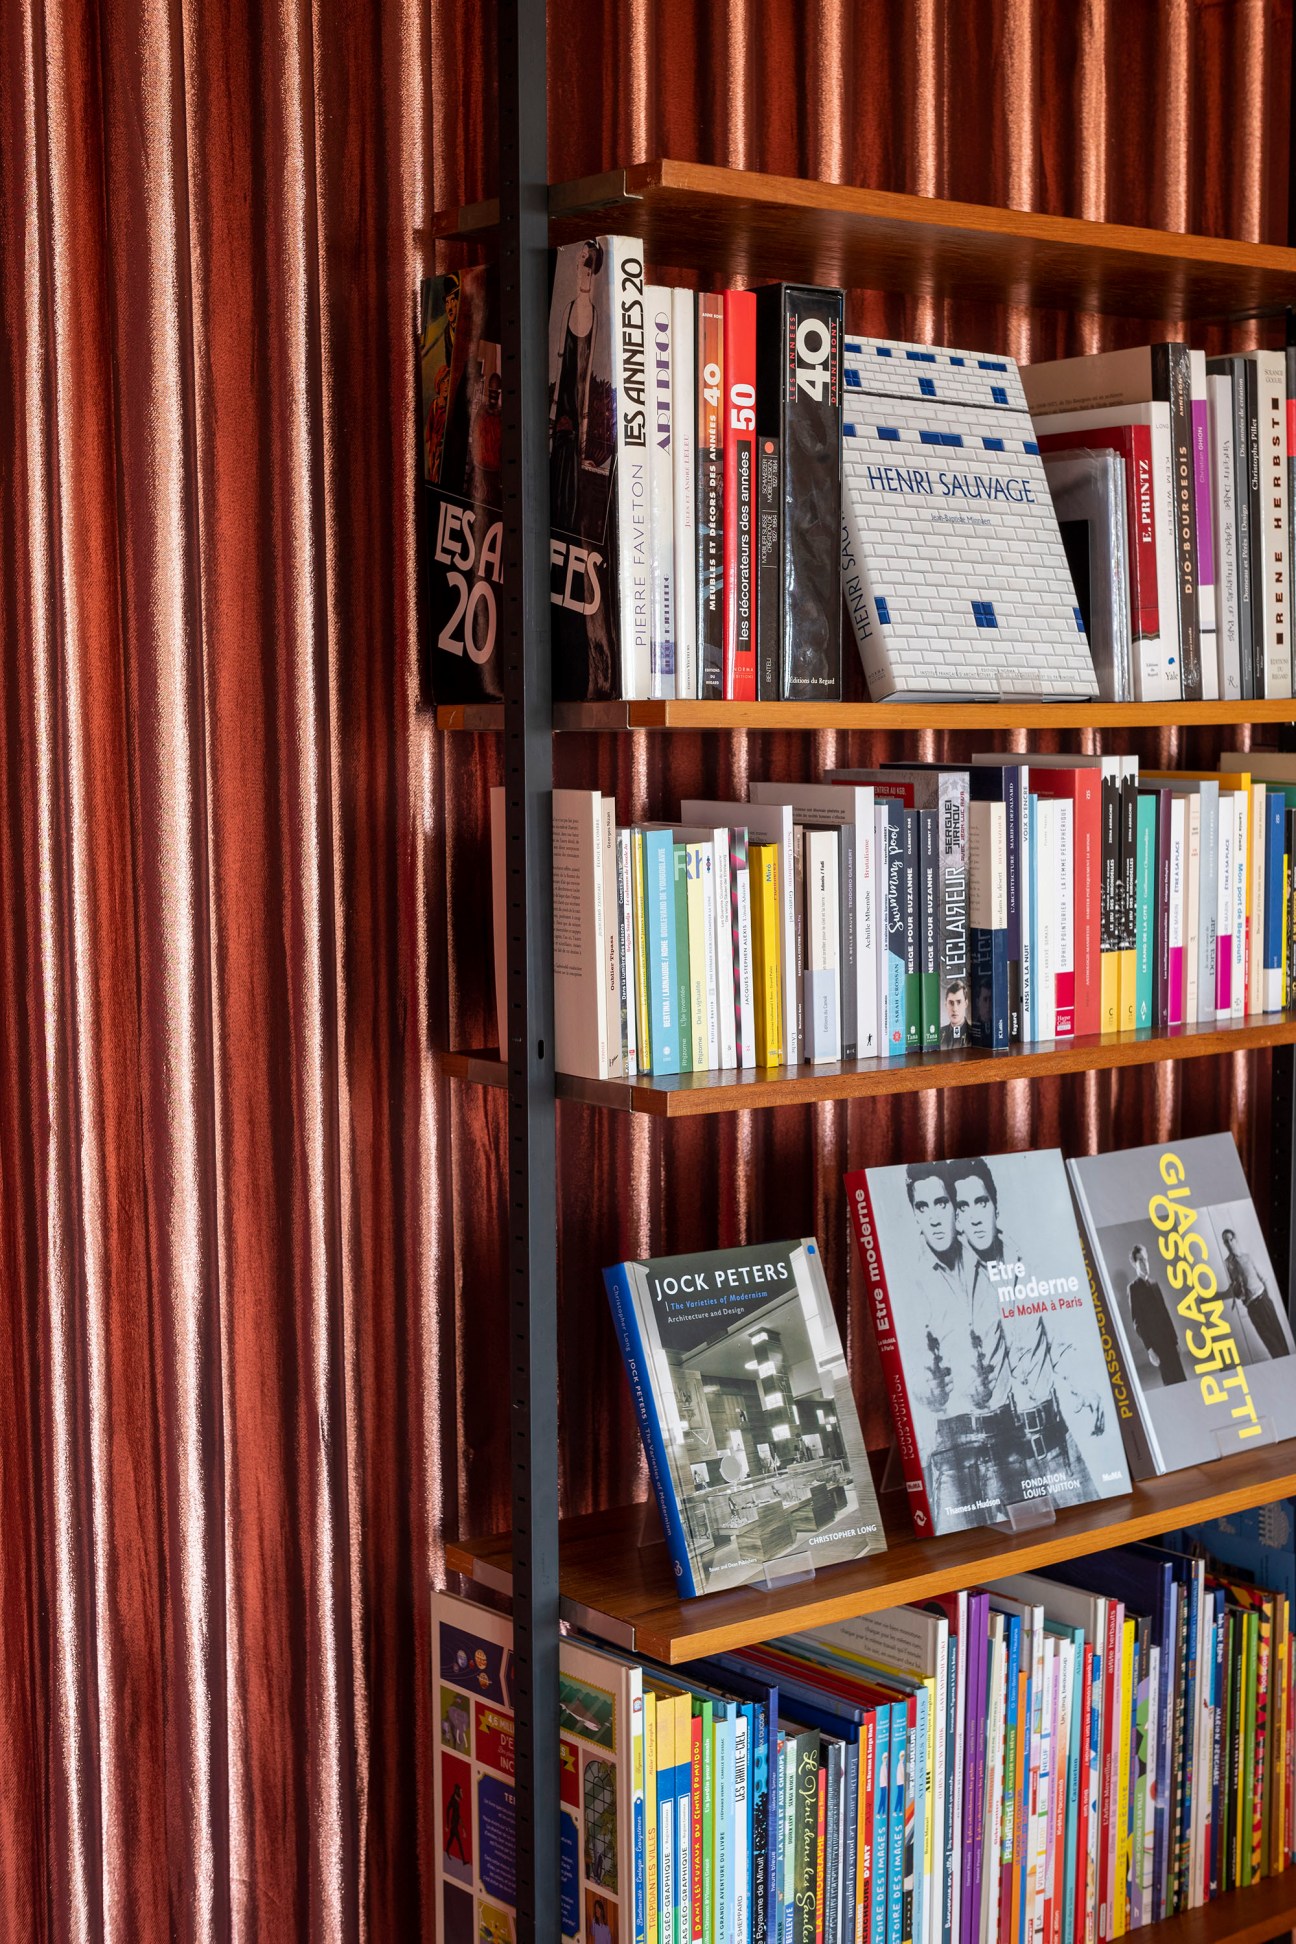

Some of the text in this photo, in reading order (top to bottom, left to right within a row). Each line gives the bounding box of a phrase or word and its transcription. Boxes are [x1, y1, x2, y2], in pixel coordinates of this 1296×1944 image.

[620, 258, 646, 447] LES ANNEES 20
[796, 318, 831, 403] 40
[830, 322, 838, 353] BONY
[654, 311, 671, 456] ART DECO
[703, 363, 721, 407] 40
[707, 414, 717, 462] ANNÉES
[708, 464, 716, 488] DES
[866, 466, 1035, 502] HENRI SAUVAGE
[1251, 442, 1259, 490] Christophe
[707, 490, 717, 537] DÉCORS
[730, 383, 756, 641] les décorateurs des années 50
[1139, 459, 1152, 548] E. PRINTZ
[1179, 446, 1192, 594] DJO-BOURGEOIS
[1271, 417, 1283, 623] RENE HERBST
[434, 500, 476, 571] LES
[631, 464, 648, 646] PIERRE FAVETON
[709, 541, 716, 555] ET
[437, 571, 497, 664] 20
[848, 575, 873, 641] HENRI
[951, 804, 960, 849] JIRNOV
[1059, 808, 1067, 856] PÉRIPHÉRIQUE
[887, 824, 904, 933] Swimming pool
[906, 867, 914, 914] SUZANNE
[926, 867, 934, 914] SUZANNE
[1060, 882, 1066, 890] LA
[1235, 886, 1243, 906] port
[657, 848, 671, 1028] BERTINA LARNAUDIE BOULEVARD DE YOUGOSLAVIE
[926, 917, 934, 943] POUR
[1235, 922, 1244, 964] Beyrouth
[654, 1261, 788, 1301] JOCK PETERS
[854, 1188, 890, 1331] Etre moderne
[986, 1260, 1026, 1282] Etre
[670, 1289, 768, 1310] The Varieties of Modernism
[997, 1274, 1079, 1302] moderne
[1002, 1296, 1083, 1319] Le MoMA à Paris
[1148, 1194, 1230, 1406] PICASSO
[1159, 1152, 1262, 1440] GIACOMETTI
[668, 1305, 746, 1324] Architecture and Design
[628, 1358, 648, 1420] JOCK PETERS
[1021, 1472, 1066, 1489] FONDATION
[1023, 1479, 1080, 1500] LOUIS VUITTON
[808, 1523, 877, 1546] CHRISTOPHER LONG
[693, 1741, 701, 1788] POMPIDOU
[734, 1732, 746, 1784] GRATTE-CIEL
[693, 1791, 701, 1819] CENTRE
[778, 1807, 784, 1818] ET
[693, 1824, 701, 1838] DU
[777, 1844, 784, 1853] LA
[795, 1749, 818, 1943] Le Vent dans les Saules
[647, 1827, 656, 1930] TRÉPIDANTES VILLES
[847, 1838, 856, 1917] poids papillon
[876, 1826, 886, 1900] DES IMAGES
[892, 1824, 902, 1898] DES IMAGES
[662, 1851, 671, 1931] GÉO-GRAPHIQUE
[679, 1846, 688, 1926] GÉO-GRAPHIQUE
[756, 1857, 766, 1939] Royaume de Minuit
